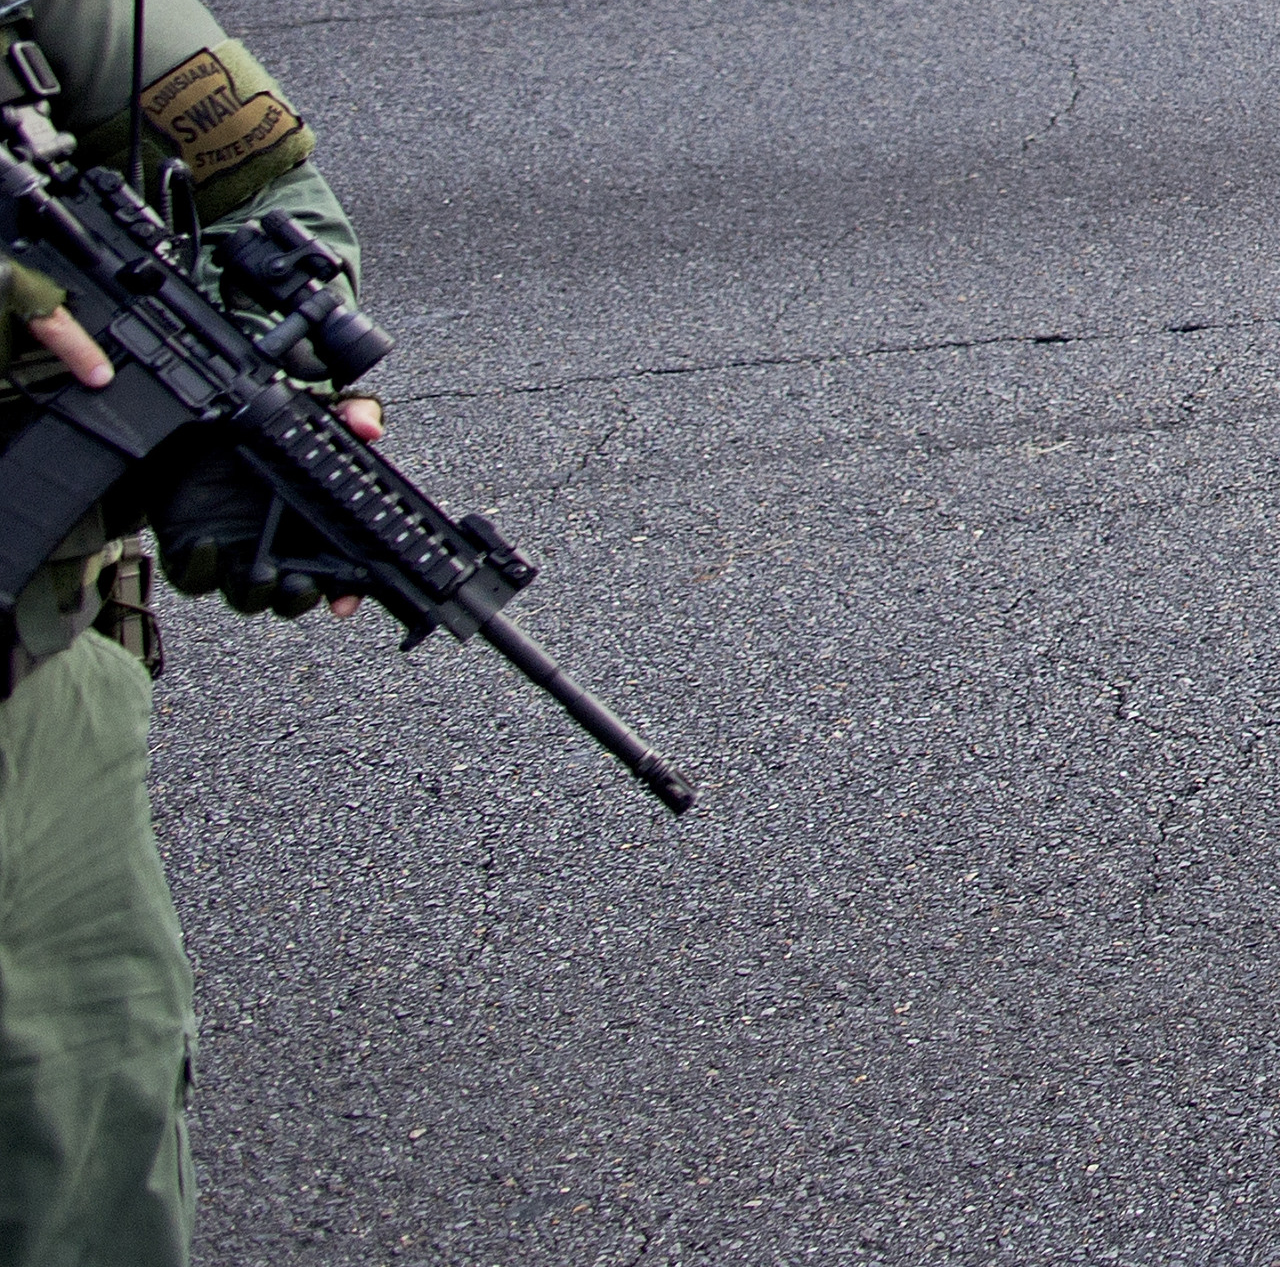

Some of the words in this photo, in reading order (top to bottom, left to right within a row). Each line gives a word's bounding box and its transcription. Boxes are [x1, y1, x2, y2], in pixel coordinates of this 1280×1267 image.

[148, 61, 221, 115] LOUISIANA
[171, 84, 239, 145] SWAT
[195, 140, 245, 169] STATE
[242, 105, 283, 149] POLICE
